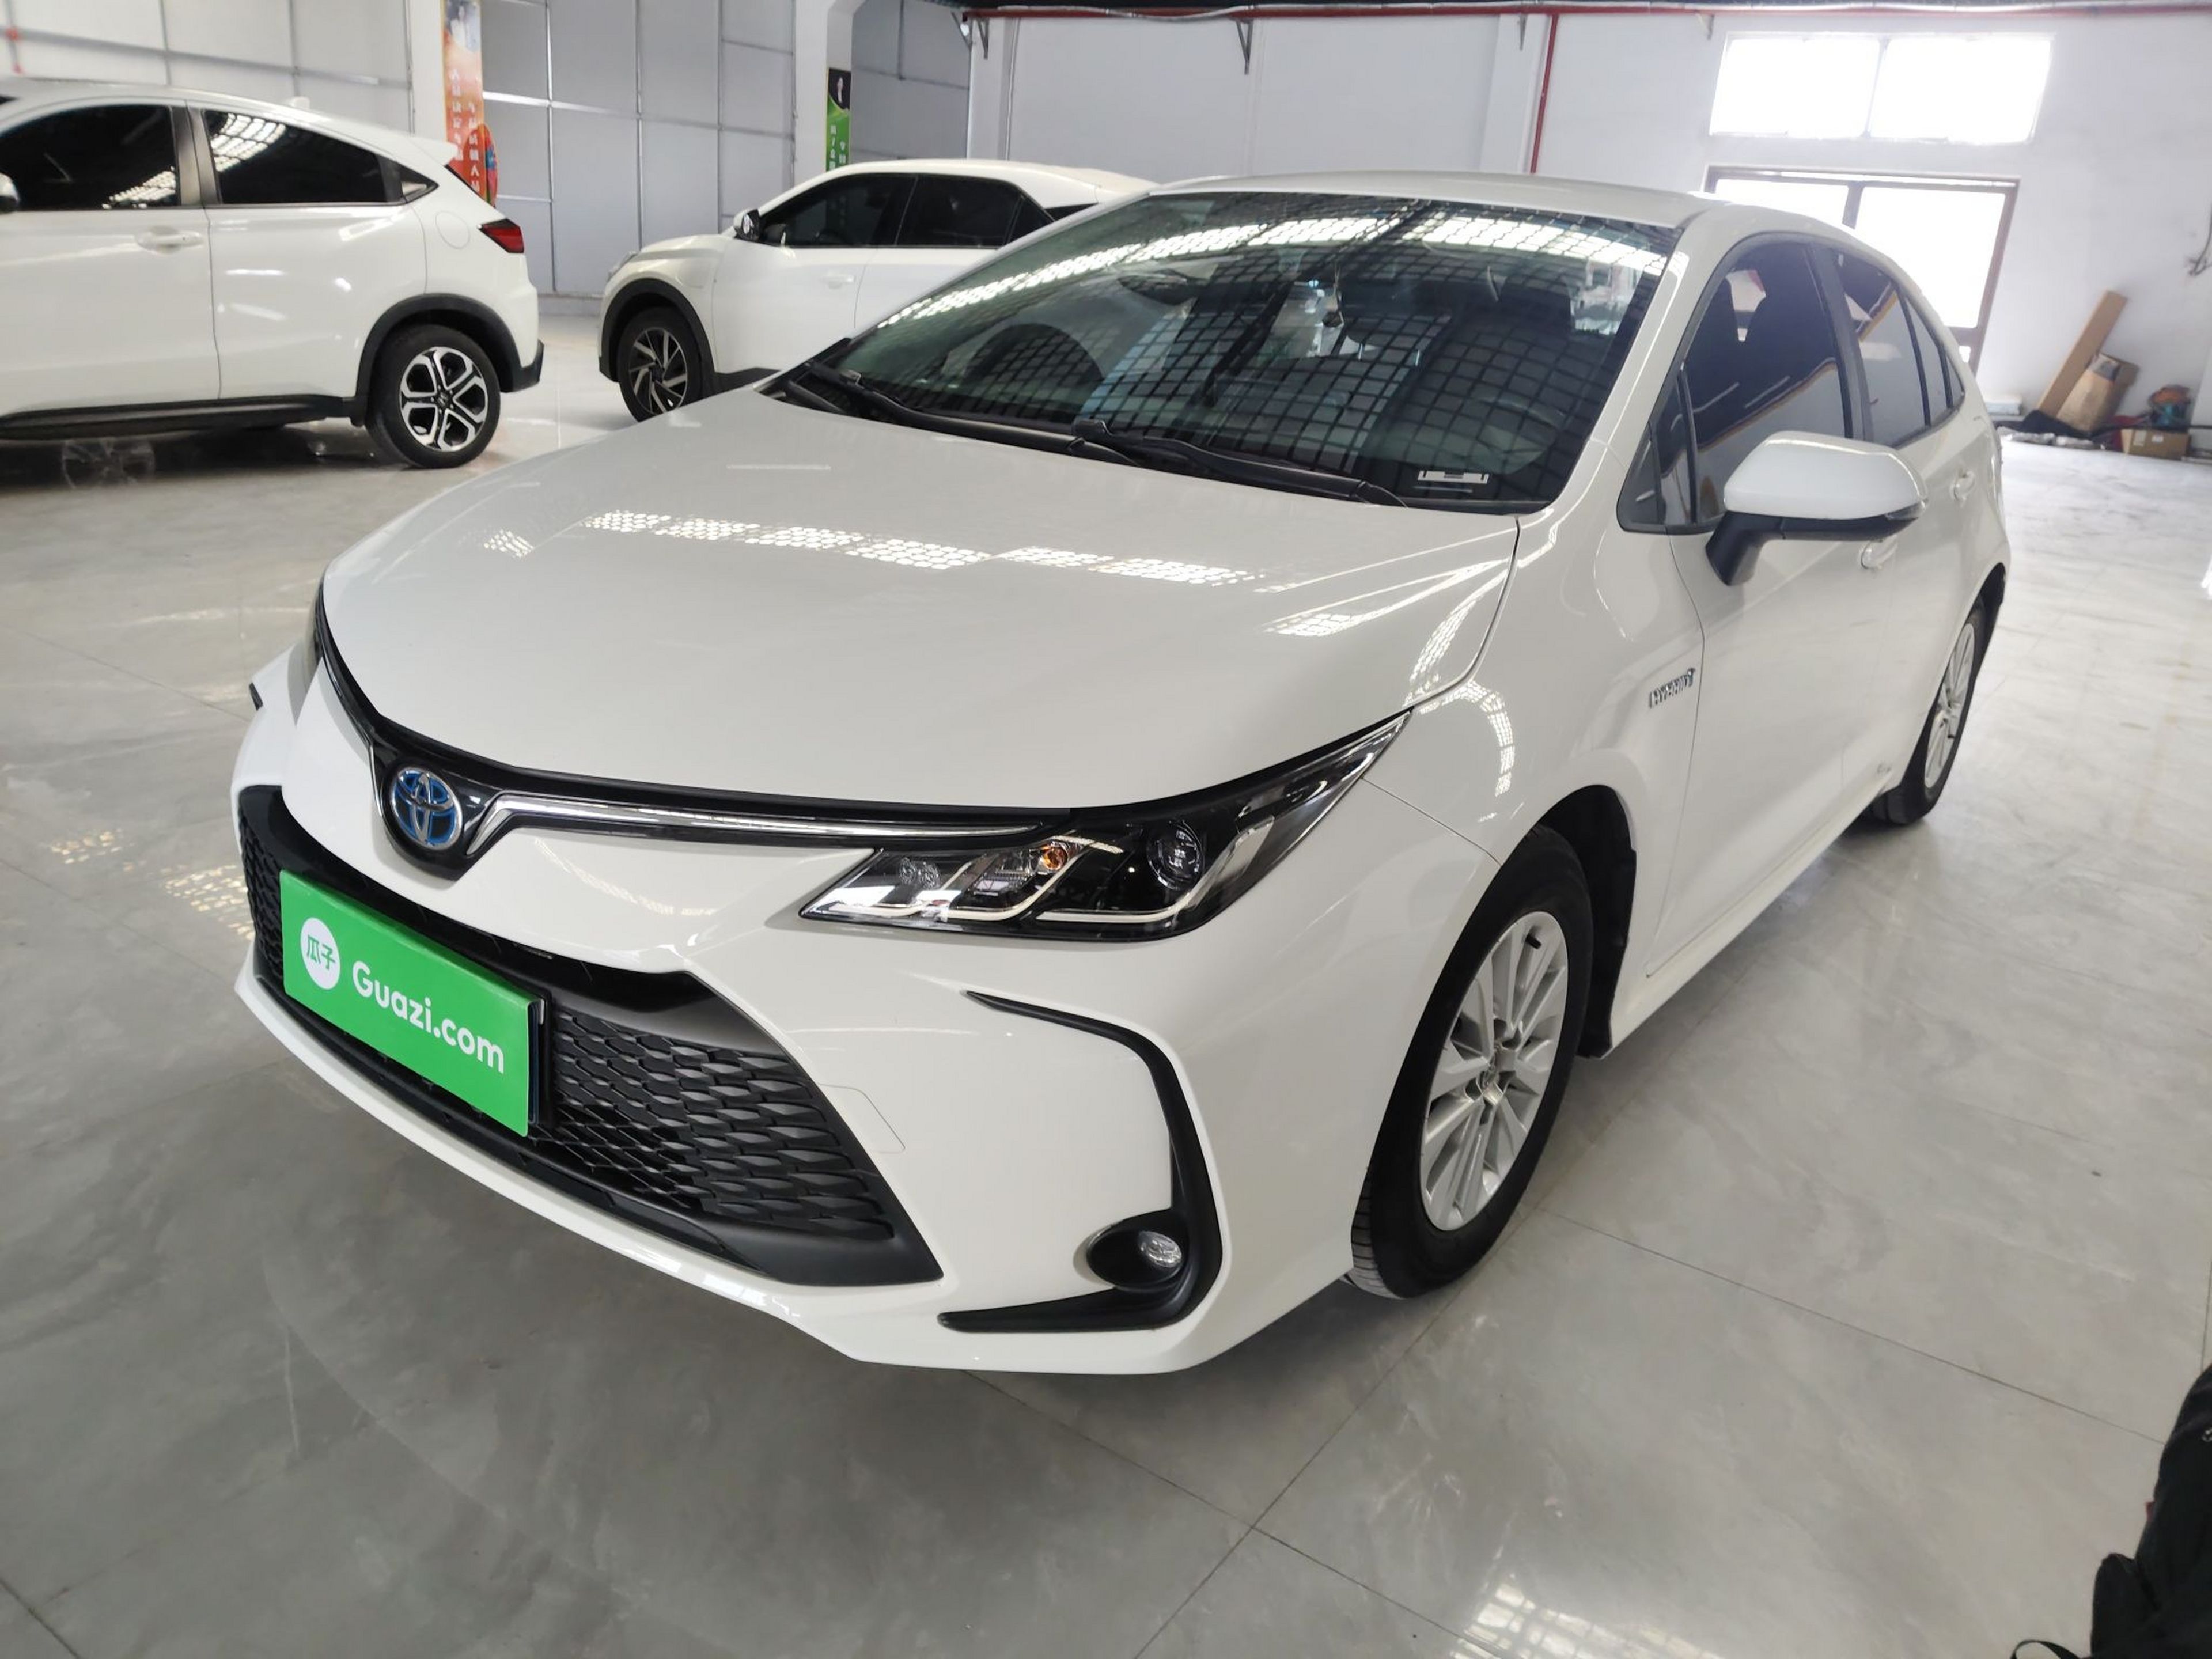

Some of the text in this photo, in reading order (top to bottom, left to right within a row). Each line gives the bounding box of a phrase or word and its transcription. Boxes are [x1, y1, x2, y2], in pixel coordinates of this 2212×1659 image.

[1649, 668, 1695, 709] HYBRID
[307, 936, 336, 970] 瓜子
[353, 961, 504, 1074] Guazi.com
